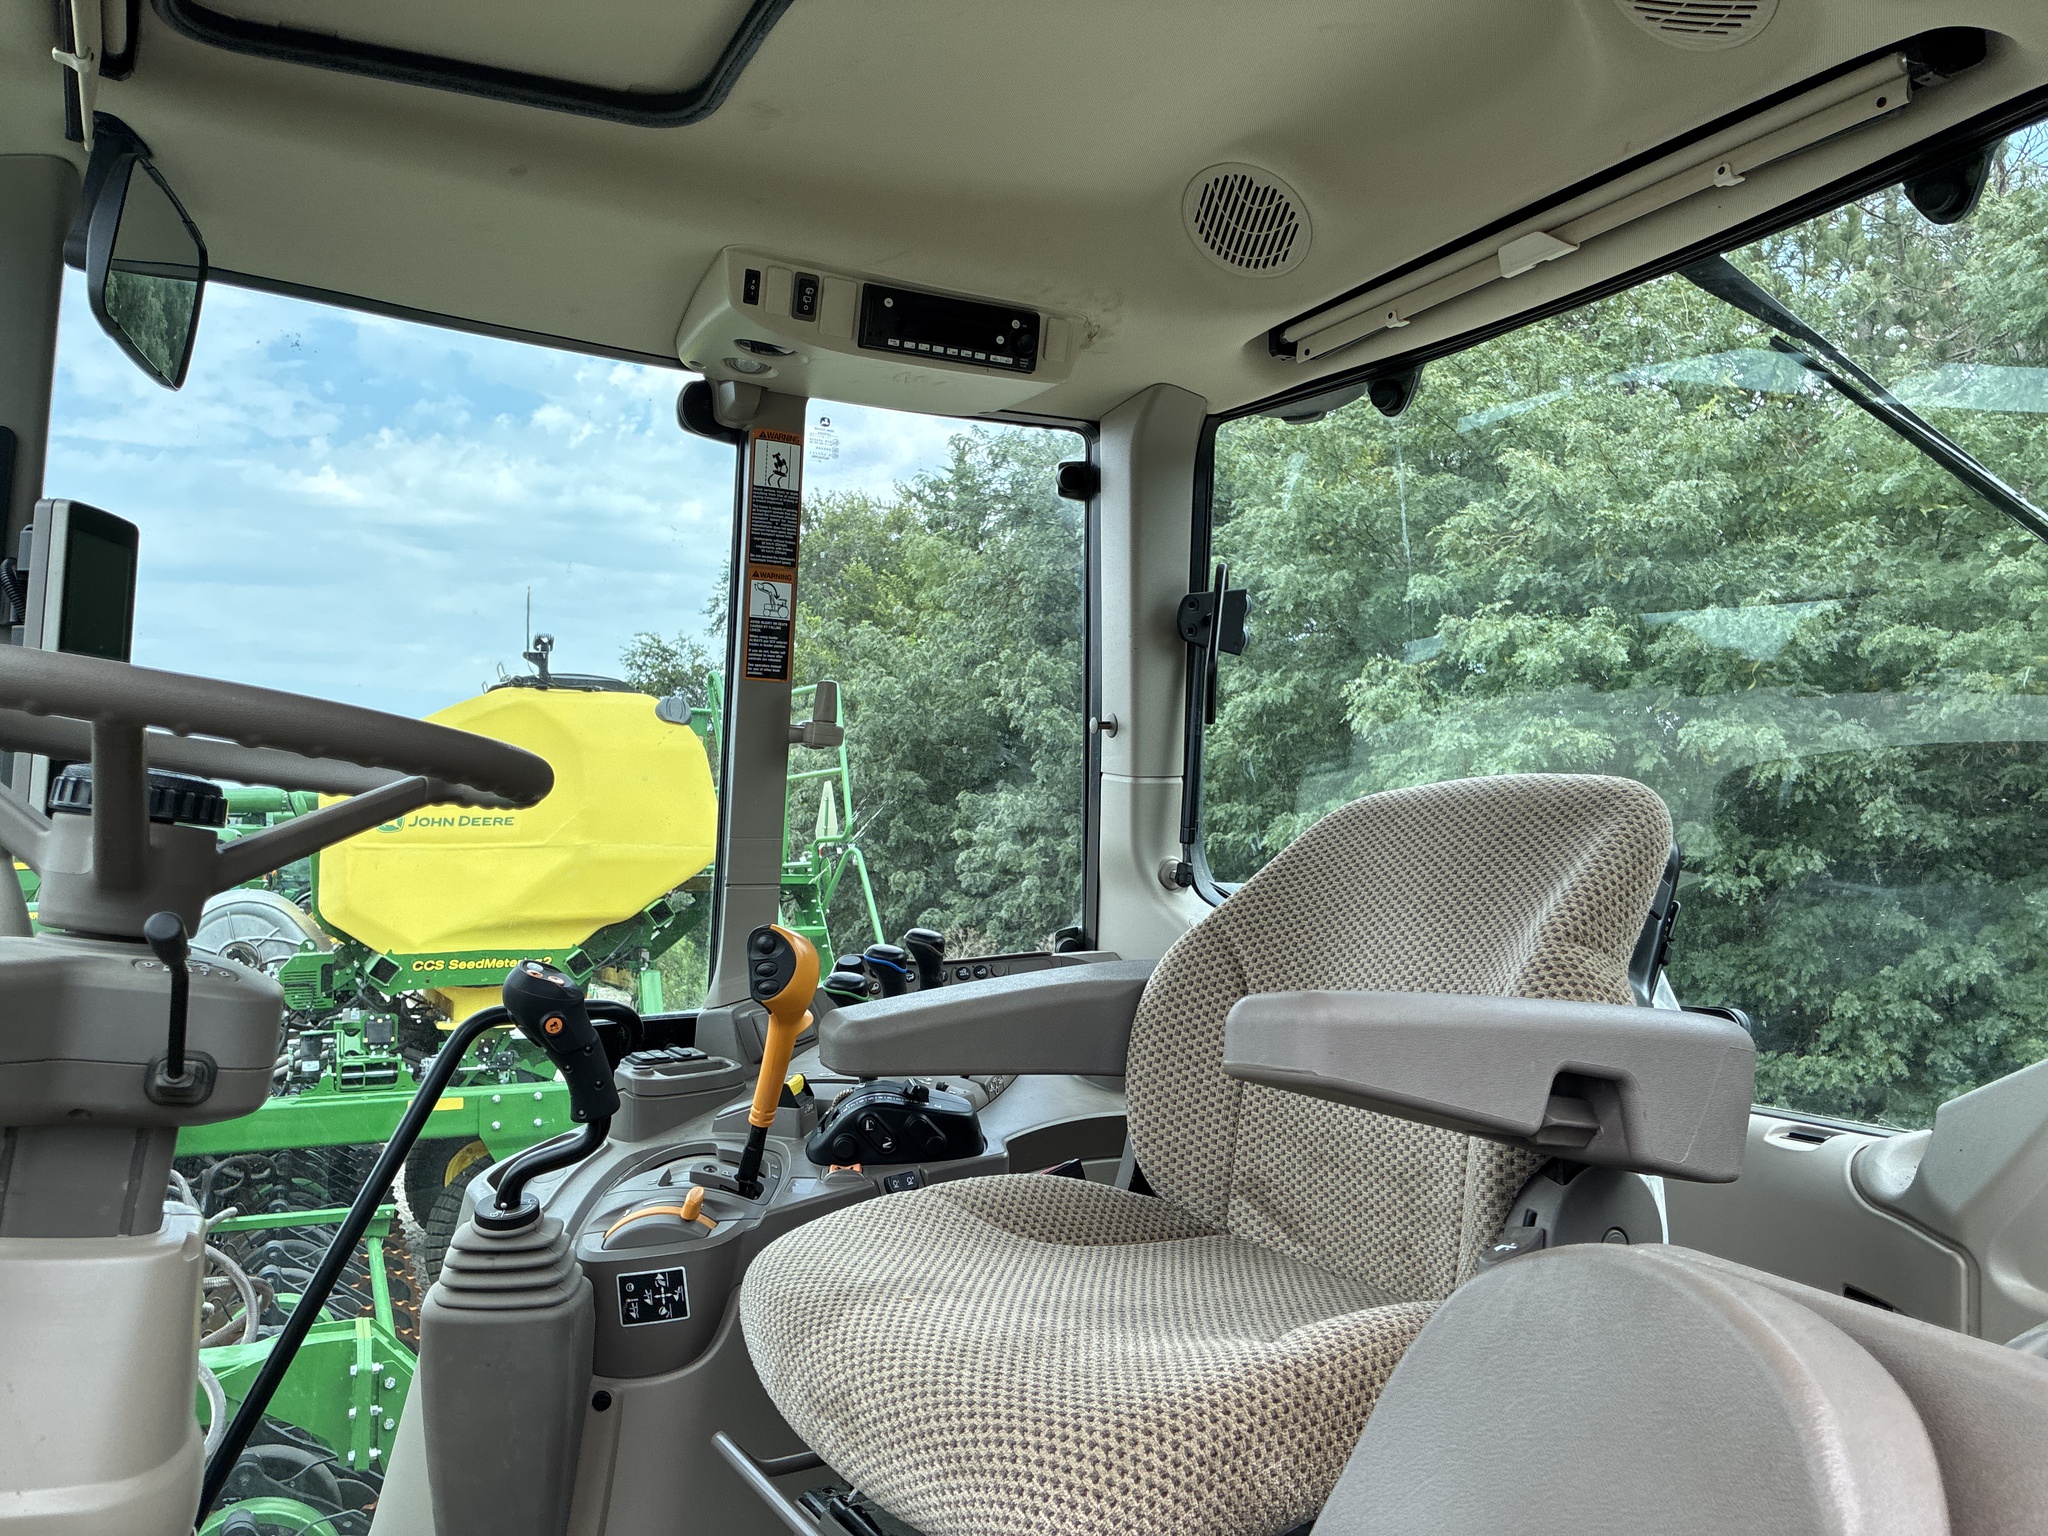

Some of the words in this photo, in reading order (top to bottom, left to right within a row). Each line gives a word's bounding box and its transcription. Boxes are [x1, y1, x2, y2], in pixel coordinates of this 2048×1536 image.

[767, 431, 800, 443] WARNING
[760, 571, 792, 581] WARNING
[408, 816, 455, 827] JOHN
[458, 815, 515, 826] DEERE
[412, 959, 445, 972] CCS
[448, 956, 552, 971] SeedMete2
